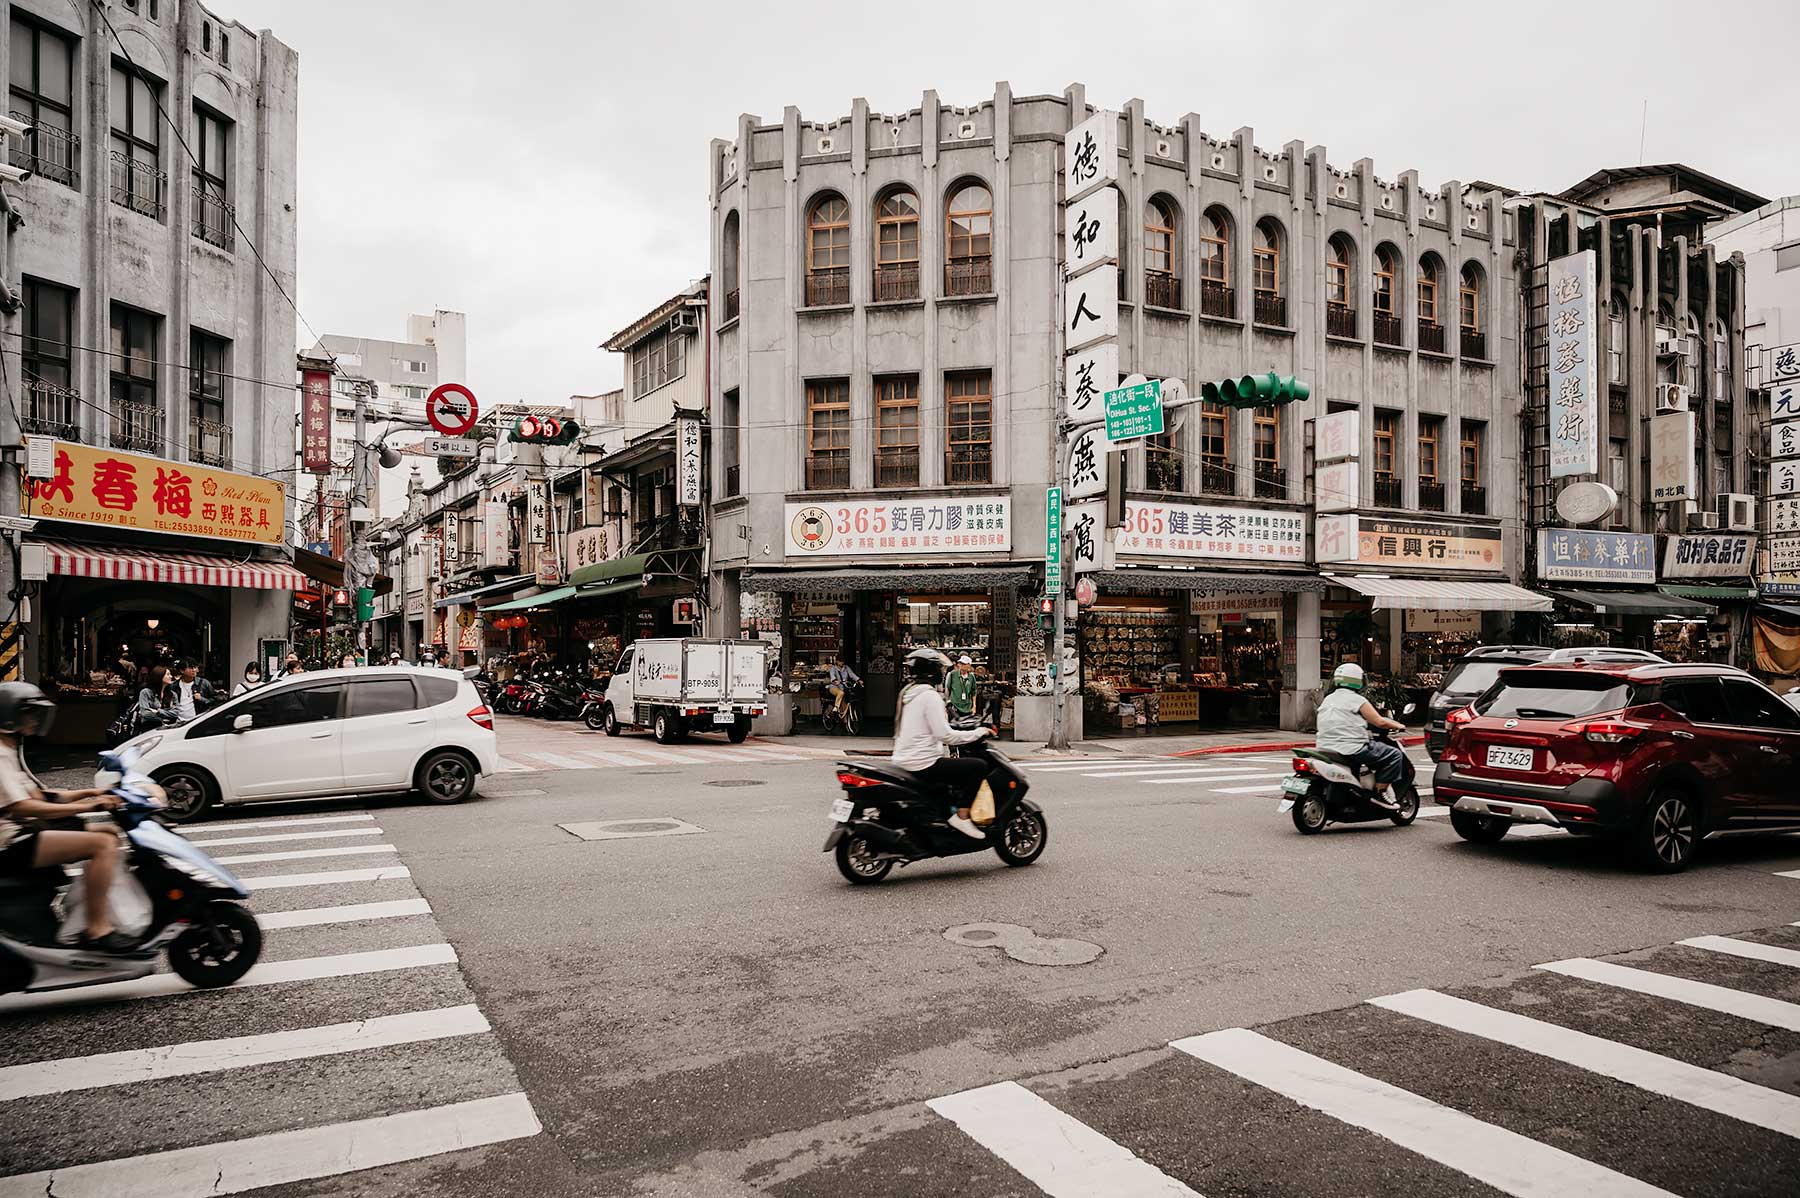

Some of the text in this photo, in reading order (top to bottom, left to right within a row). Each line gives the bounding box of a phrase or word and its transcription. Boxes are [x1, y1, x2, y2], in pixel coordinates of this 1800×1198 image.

[543, 423, 554, 438] 19
[58, 507, 86, 520] Since
[89, 511, 114, 522] 1919
[202, 503, 270, 530] 西點器具
[800, 510, 824, 520] 365
[837, 506, 887, 534] 365
[1168, 510, 1236, 538] 健美茶
[1378, 535, 1447, 558] 信興行
[1676, 538, 1747, 564] 和村食品行
[687, 679, 719, 688] BTP-9058
